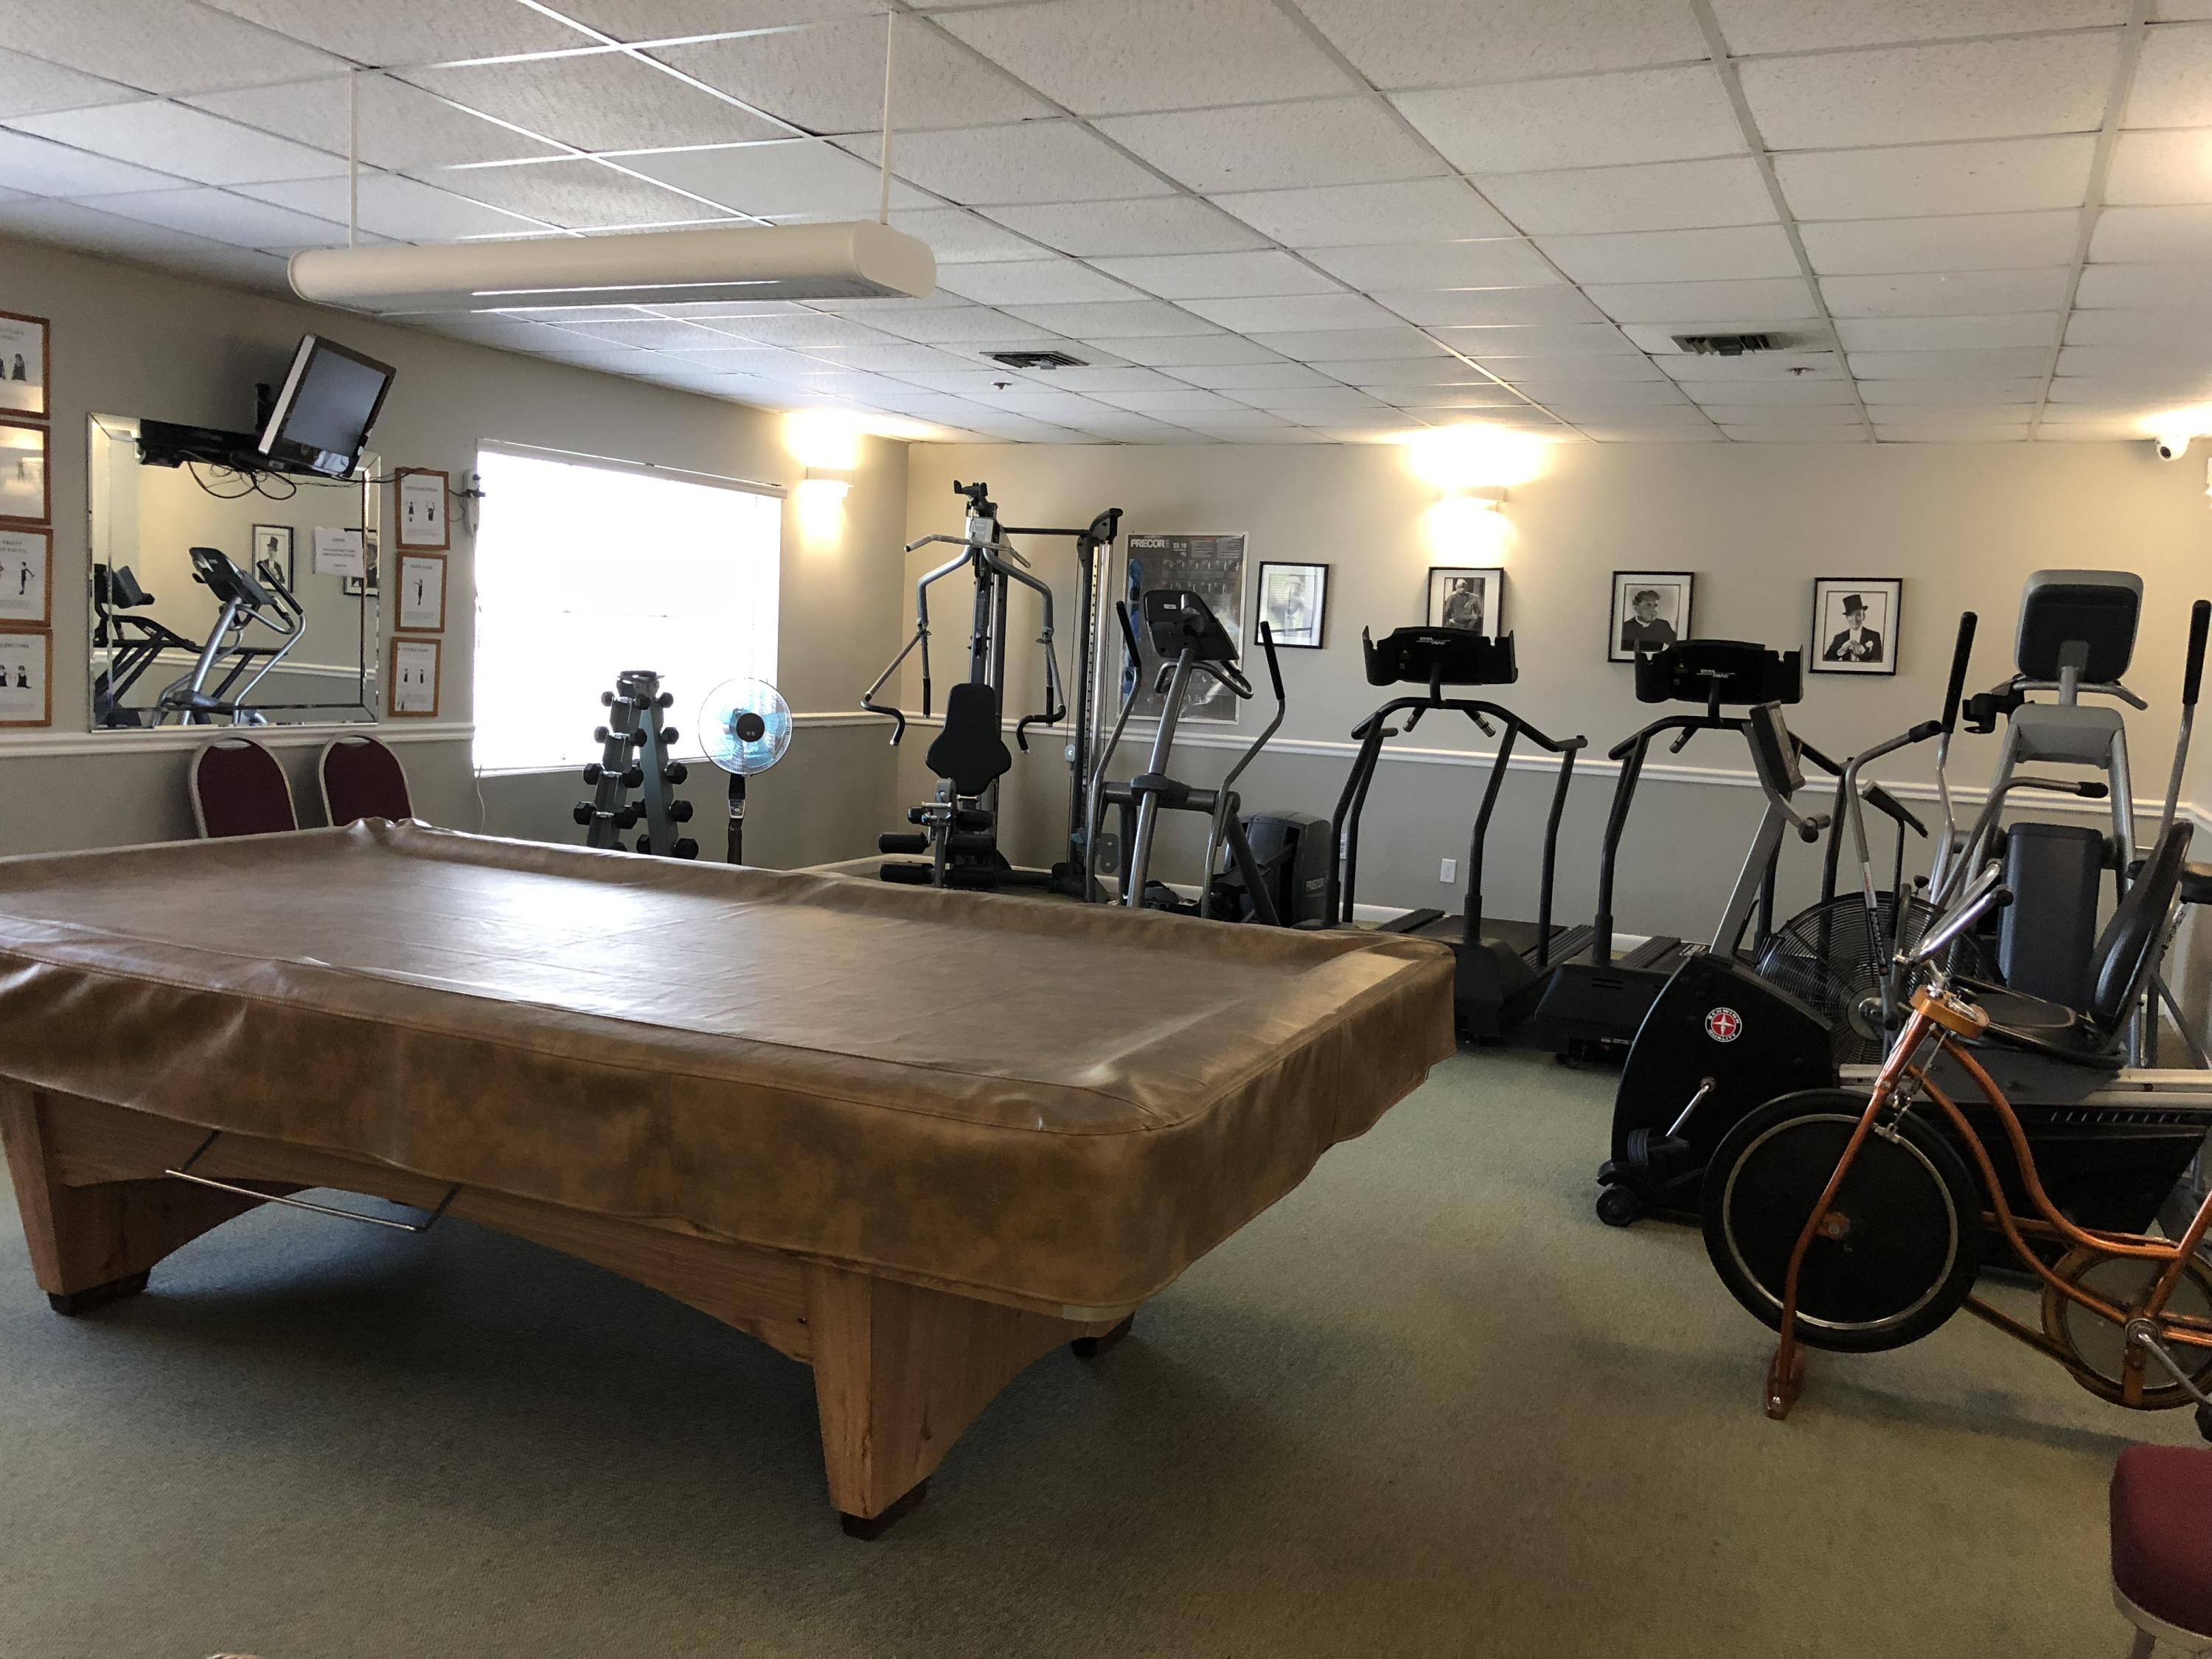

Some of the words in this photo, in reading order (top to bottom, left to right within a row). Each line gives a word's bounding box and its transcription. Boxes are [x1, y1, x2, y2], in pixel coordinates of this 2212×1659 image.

[1130, 539, 1165, 548] PRECOR
[1708, 1009, 1740, 1024] SCHWINN
[1708, 1029, 1736, 1040] QUALITY
